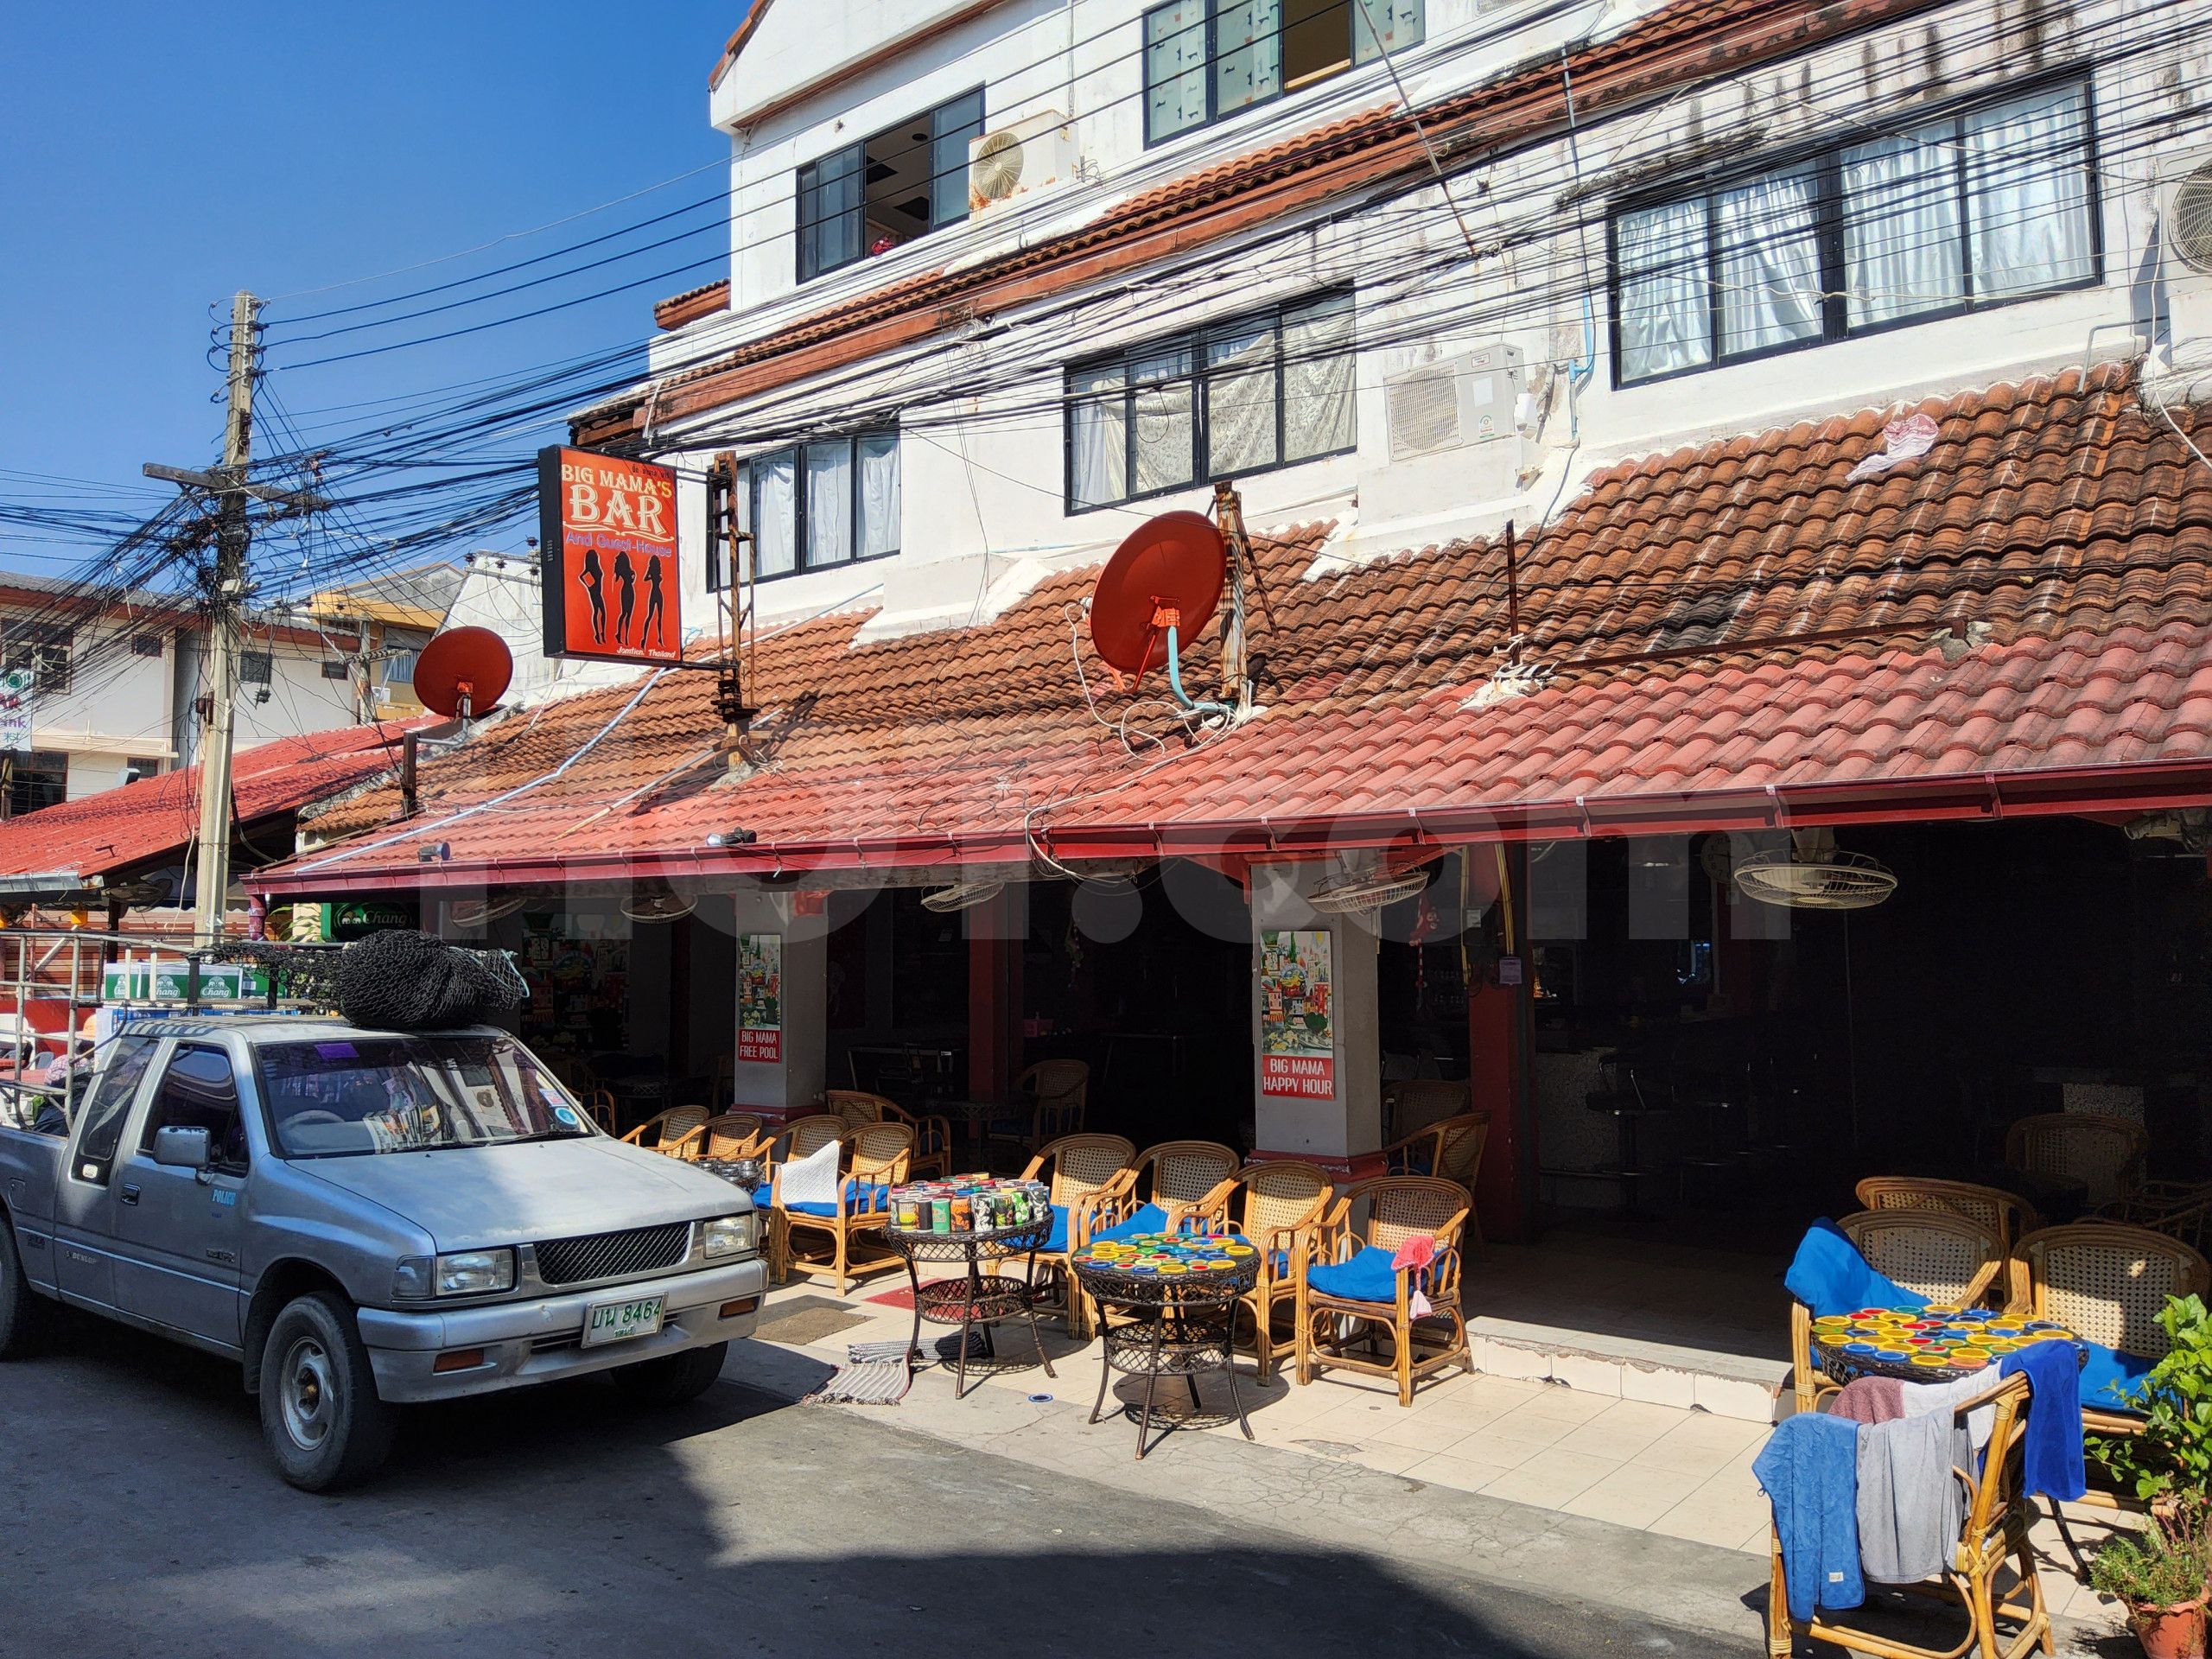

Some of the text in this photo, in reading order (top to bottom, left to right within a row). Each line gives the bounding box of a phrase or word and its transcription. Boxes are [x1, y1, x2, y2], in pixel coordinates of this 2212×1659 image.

[561, 464, 672, 498] BIG MAMA'S
[569, 484, 666, 535] BAR
[566, 531, 593, 547] And
[648, 648, 676, 658] Thailand
[363, 910, 406, 926] Chang
[156, 987, 179, 998] hang
[201, 987, 230, 998] Chang
[741, 1031, 777, 1044] BIG MAMA
[740, 1046, 779, 1059] FREE POOL
[1269, 1058, 1325, 1076] BIG MAMA
[1263, 1076, 1332, 1095] HAPPY HOUR
[621, 1300, 662, 1324] 8464
